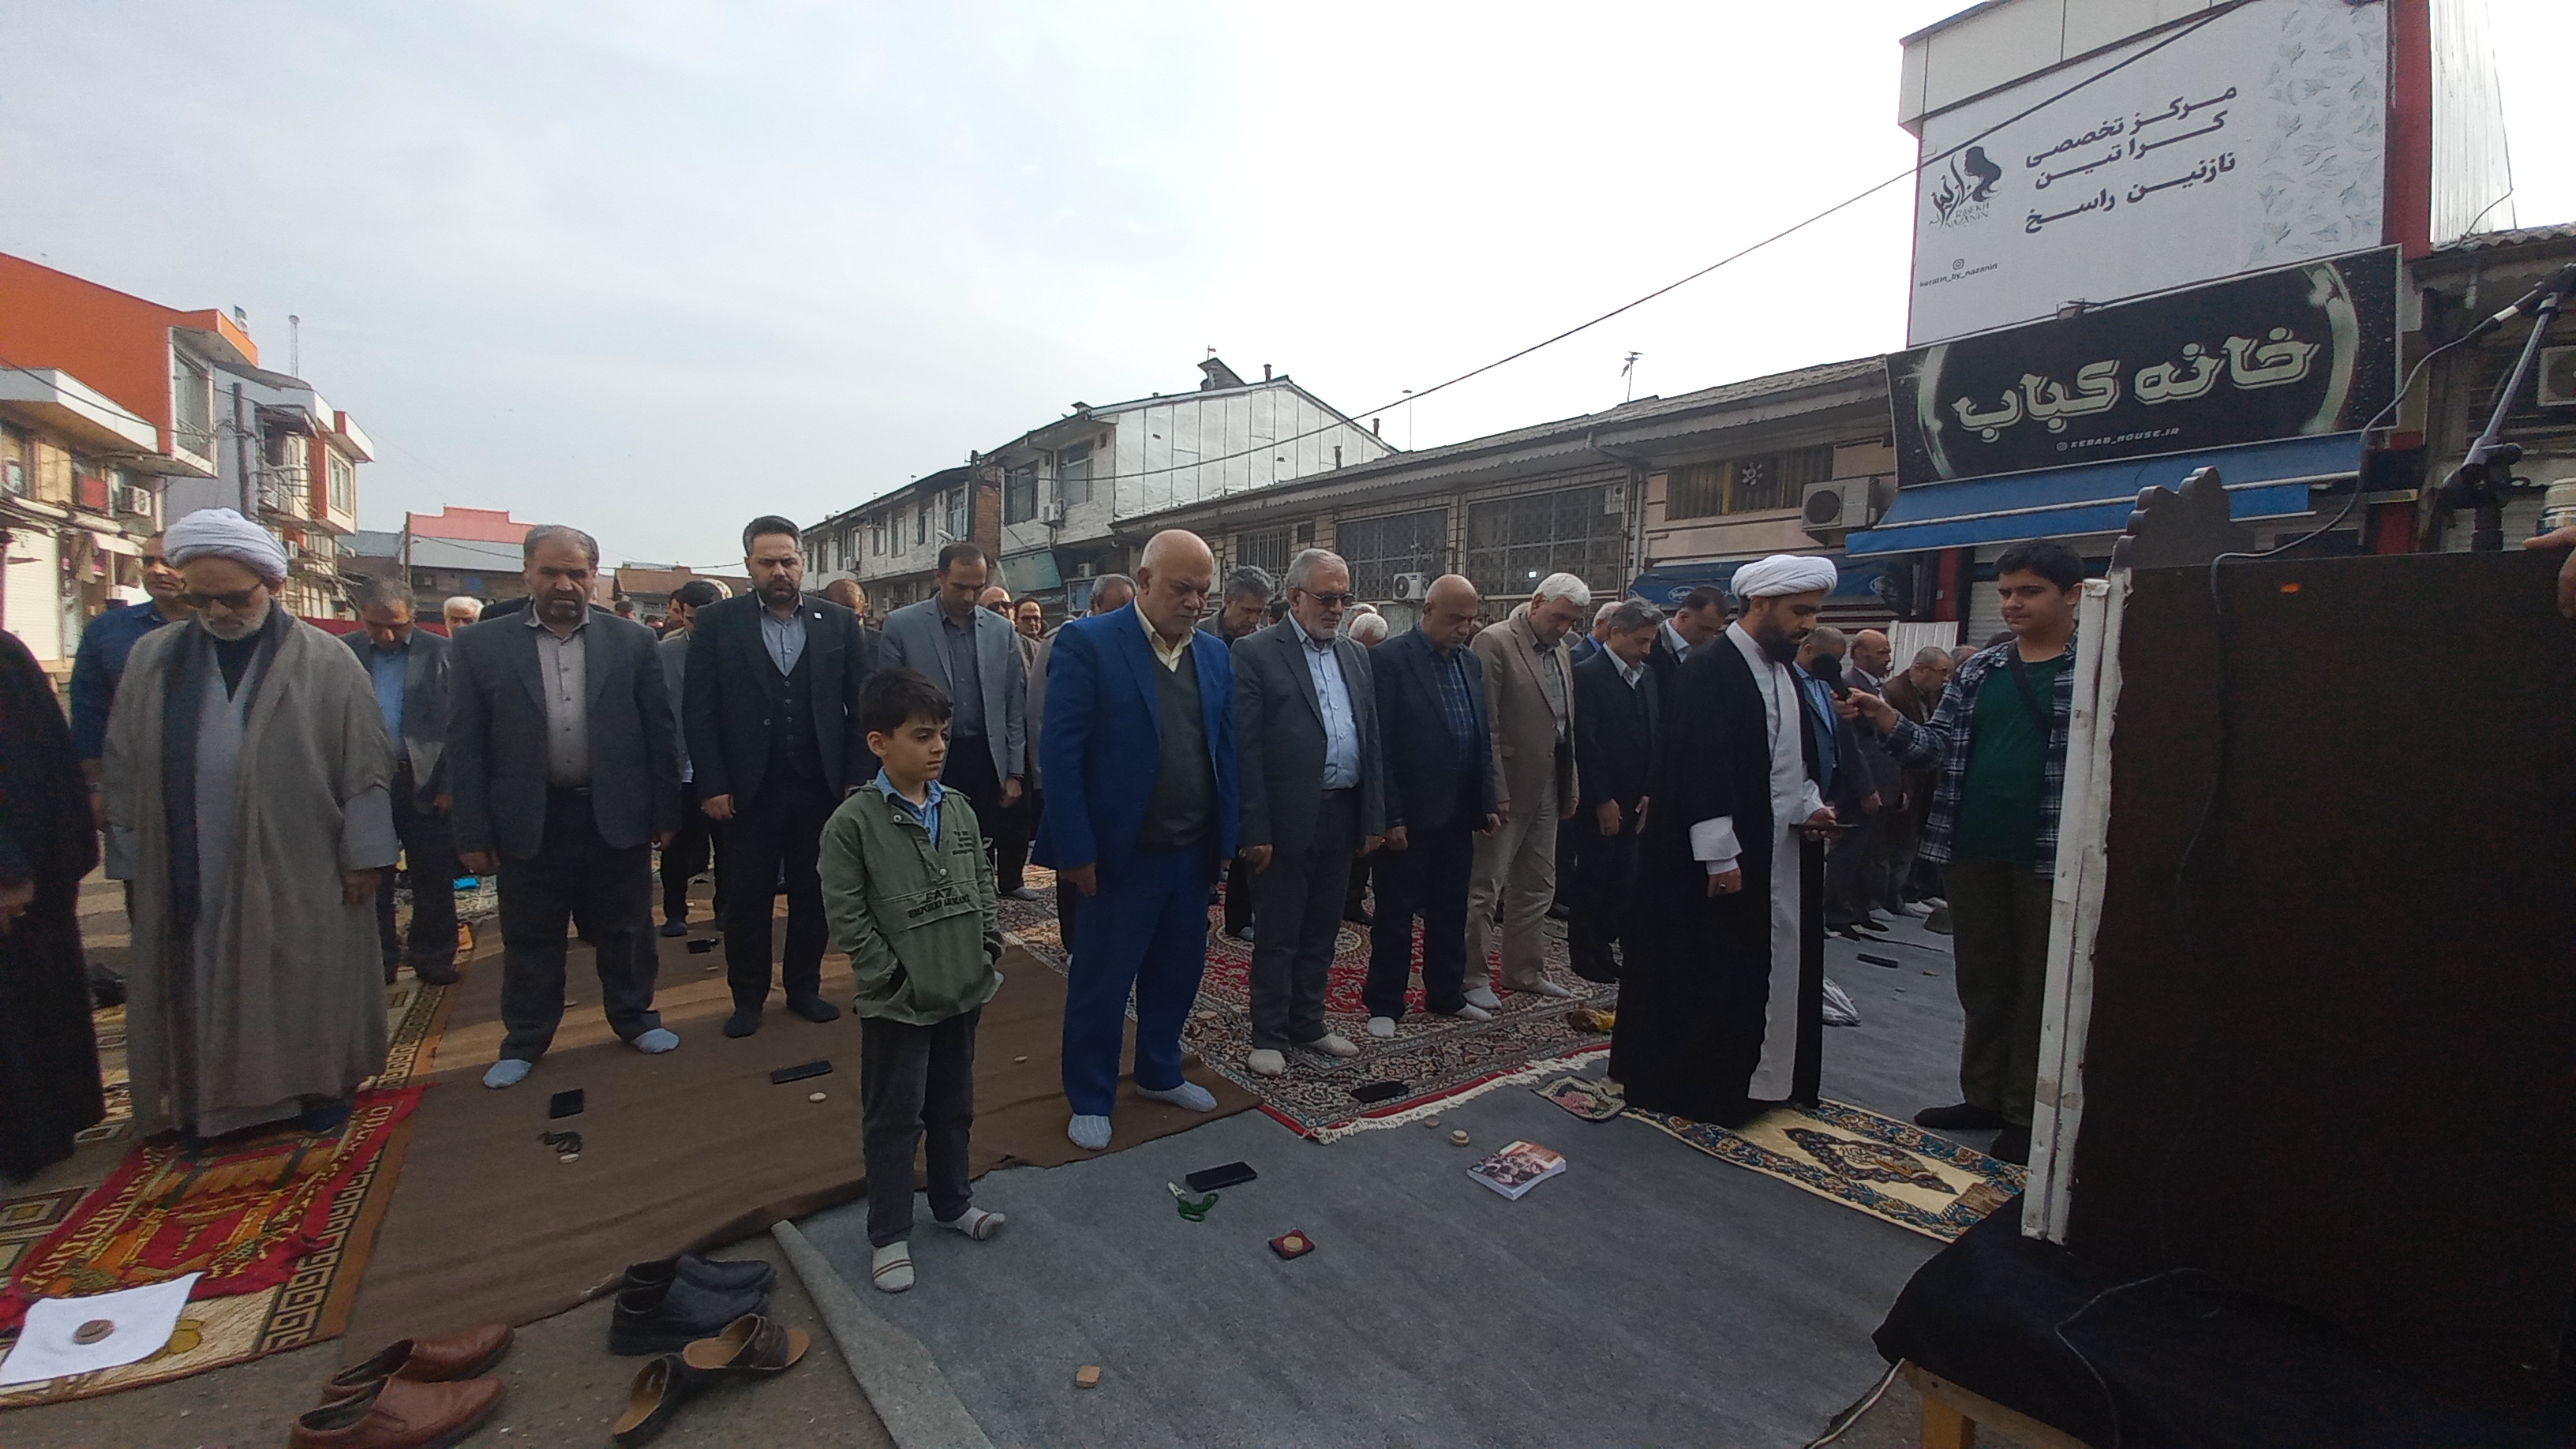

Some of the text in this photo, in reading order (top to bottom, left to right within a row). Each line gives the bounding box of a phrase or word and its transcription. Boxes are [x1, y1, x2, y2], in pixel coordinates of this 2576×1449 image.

[2026, 86, 2237, 168] مرکز تخصصی
[2025, 152, 2236, 234] نازنین راسخ
[1951, 327, 2320, 443] خانه کباب
